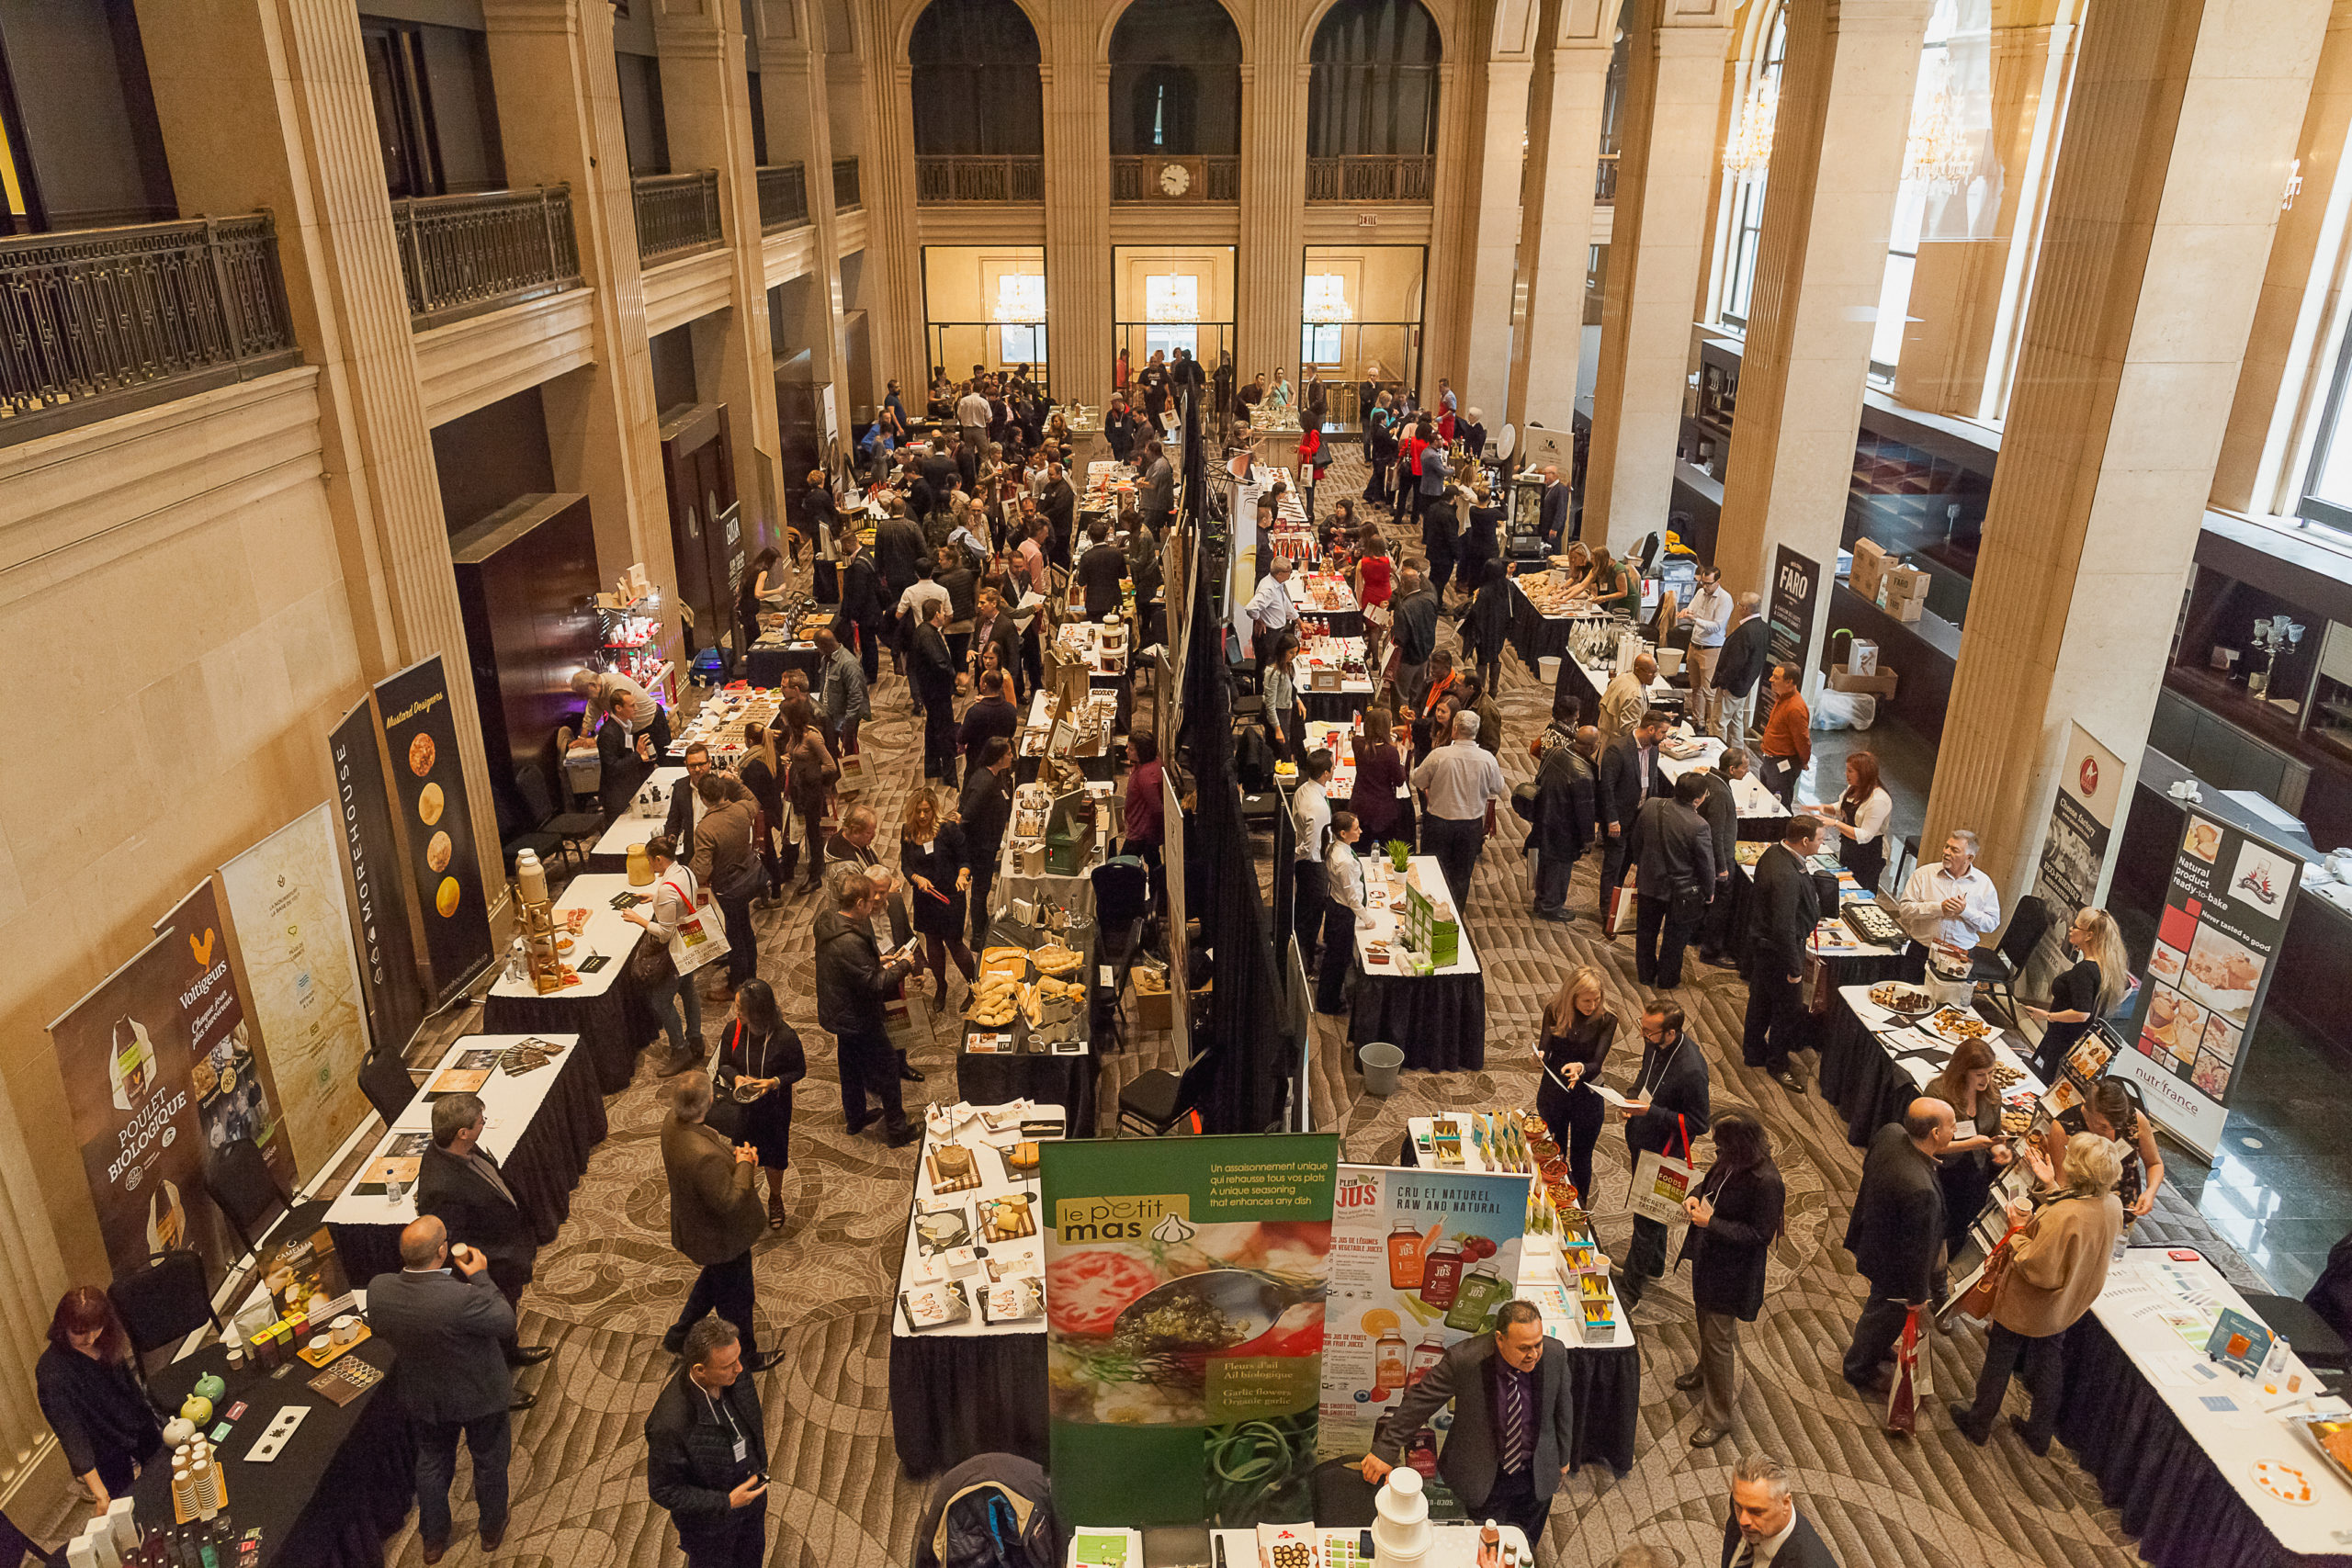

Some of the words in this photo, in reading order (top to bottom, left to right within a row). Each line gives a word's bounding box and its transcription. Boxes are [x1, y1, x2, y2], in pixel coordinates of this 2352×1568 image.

[1779, 565, 1808, 599] FARO
[1894, 576, 1908, 589] FARO
[387, 705, 413, 730] Mustard
[413, 691, 443, 714] Designers
[2060, 797, 2078, 819] Cheese
[2077, 814, 2096, 838] factory
[336, 744, 372, 923] MOREHOUSE
[2178, 855, 2211, 878] Natural
[2043, 861, 2081, 902] ECO-FRIENDLY
[2175, 865, 2211, 889] product
[2173, 875, 2229, 911] ready-to-bake
[2200, 909, 2220, 925] Never
[2220, 921, 2243, 936] tasted
[2242, 933, 2250, 942] so
[2250, 938, 2272, 953] good
[438, 953, 488, 998] morehousefoods.ca
[179, 960, 227, 1010] Voltigeurs
[191, 1004, 214, 1034] Chaque
[213, 988, 228, 1011] jour
[192, 1027, 205, 1051] plus
[204, 994, 233, 1032] savoureux
[118, 1087, 166, 1149] POULET
[107, 1090, 187, 1184] BIOLOGIQUE
[1210, 1163, 1223, 1173] Un
[1225, 1162, 1295, 1173] assaisonnement
[1297, 1161, 1329, 1172] unique
[1210, 1175, 1225, 1186] qui
[1226, 1175, 1265, 1184] rehausse
[1267, 1174, 1285, 1183] tous
[1304, 1173, 1326, 1183] plats
[1340, 1178, 1358, 1187] PLEIN
[1657, 1173, 1682, 1188] FOODS
[1210, 1187, 1217, 1196] A
[1219, 1186, 1250, 1196] unique
[1251, 1185, 1296, 1196] seasoning
[1335, 1185, 1377, 1208] JUS
[1397, 1186, 1419, 1199] CRU
[1424, 1187, 1436, 1199] ET
[1442, 1189, 1490, 1201] NATUREL
[1210, 1198, 1228, 1207] that
[1229, 1197, 1274, 1207] enhances
[1275, 1197, 1293, 1206] any
[1294, 1196, 1312, 1206] dish
[1396, 1199, 1420, 1210] RAW
[1426, 1200, 1447, 1212] AND
[1453, 1201, 1501, 1214] NATURAL
[1640, 1195, 1667, 1210] SECRETS
[1064, 1208, 1084, 1222] le
[1091, 1198, 1163, 1223] petit
[1638, 1201, 1657, 1213] TASTE
[1666, 1213, 1690, 1225] FUTURE
[1065, 1222, 1143, 1241] mas
[276, 1241, 314, 1261] CAMELLIA
[1398, 1245, 1414, 1257] JUS
[1397, 1261, 1402, 1270] 1
[1434, 1267, 1452, 1278] JUS
[1430, 1280, 1437, 1290] 2
[1467, 1286, 1487, 1299] JUS
[1457, 1300, 1464, 1308] 5
[1224, 1362, 1255, 1371] Fleurs
[1257, 1360, 1278, 1370] d'ail
[311, 1373, 337, 1388] Tea
[1224, 1371, 1238, 1380] Ail
[1240, 1370, 1294, 1380] biologique
[1256, 1387, 1292, 1396] flowers
[1223, 1397, 1262, 1406] Organic
[1264, 1396, 1291, 1405] garlic
